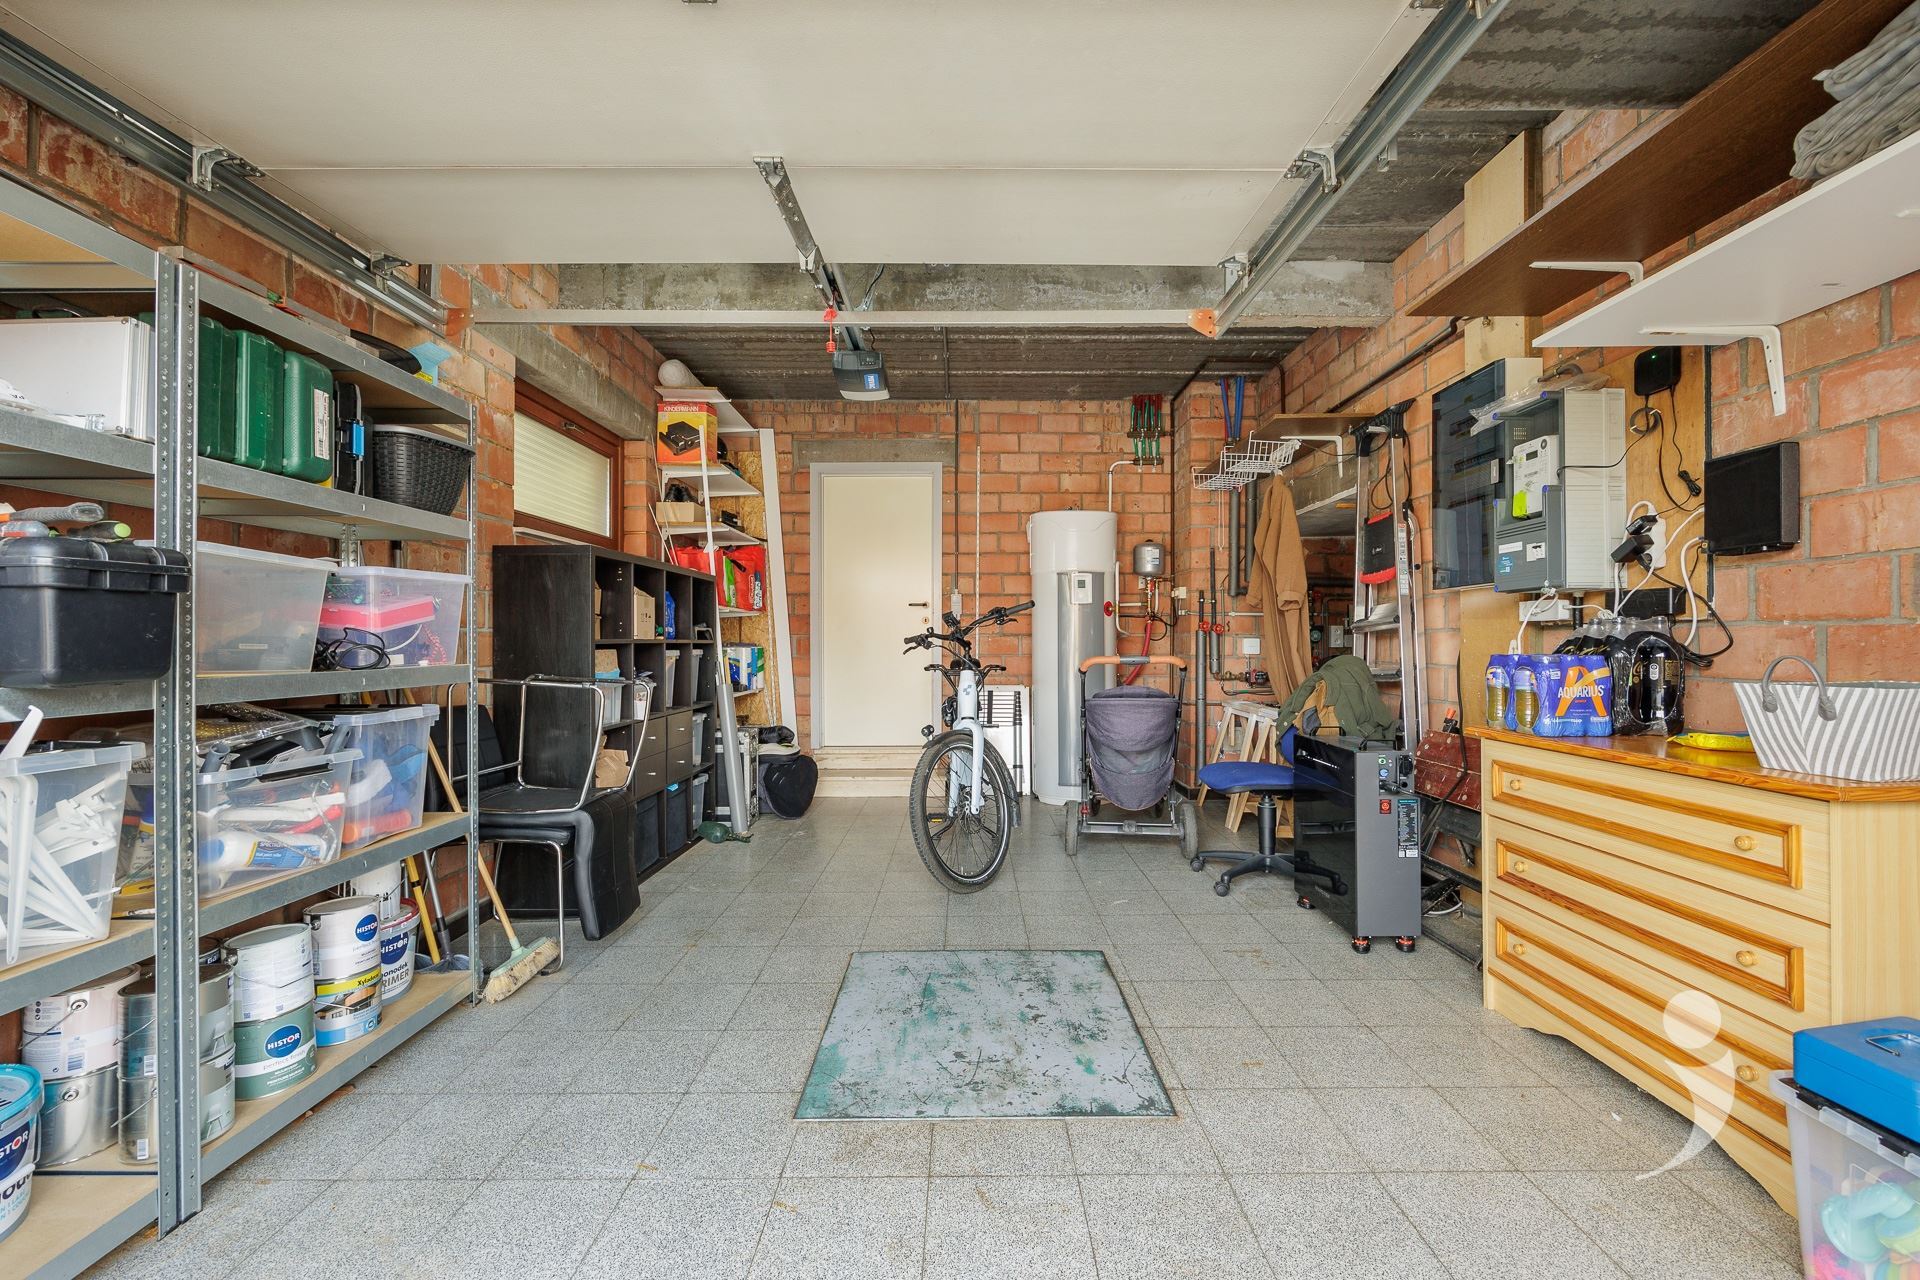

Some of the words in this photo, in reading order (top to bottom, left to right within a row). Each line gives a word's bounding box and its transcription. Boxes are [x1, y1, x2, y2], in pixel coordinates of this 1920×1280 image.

[1557, 685, 1605, 698] AQUARIUS
[356, 921, 378, 934] HISTOR
[380, 937, 408, 954] HISTOR
[381, 969, 410, 988] RIMER
[267, 1032, 300, 1050] HISTOR
[0, 1131, 29, 1158] STOR
